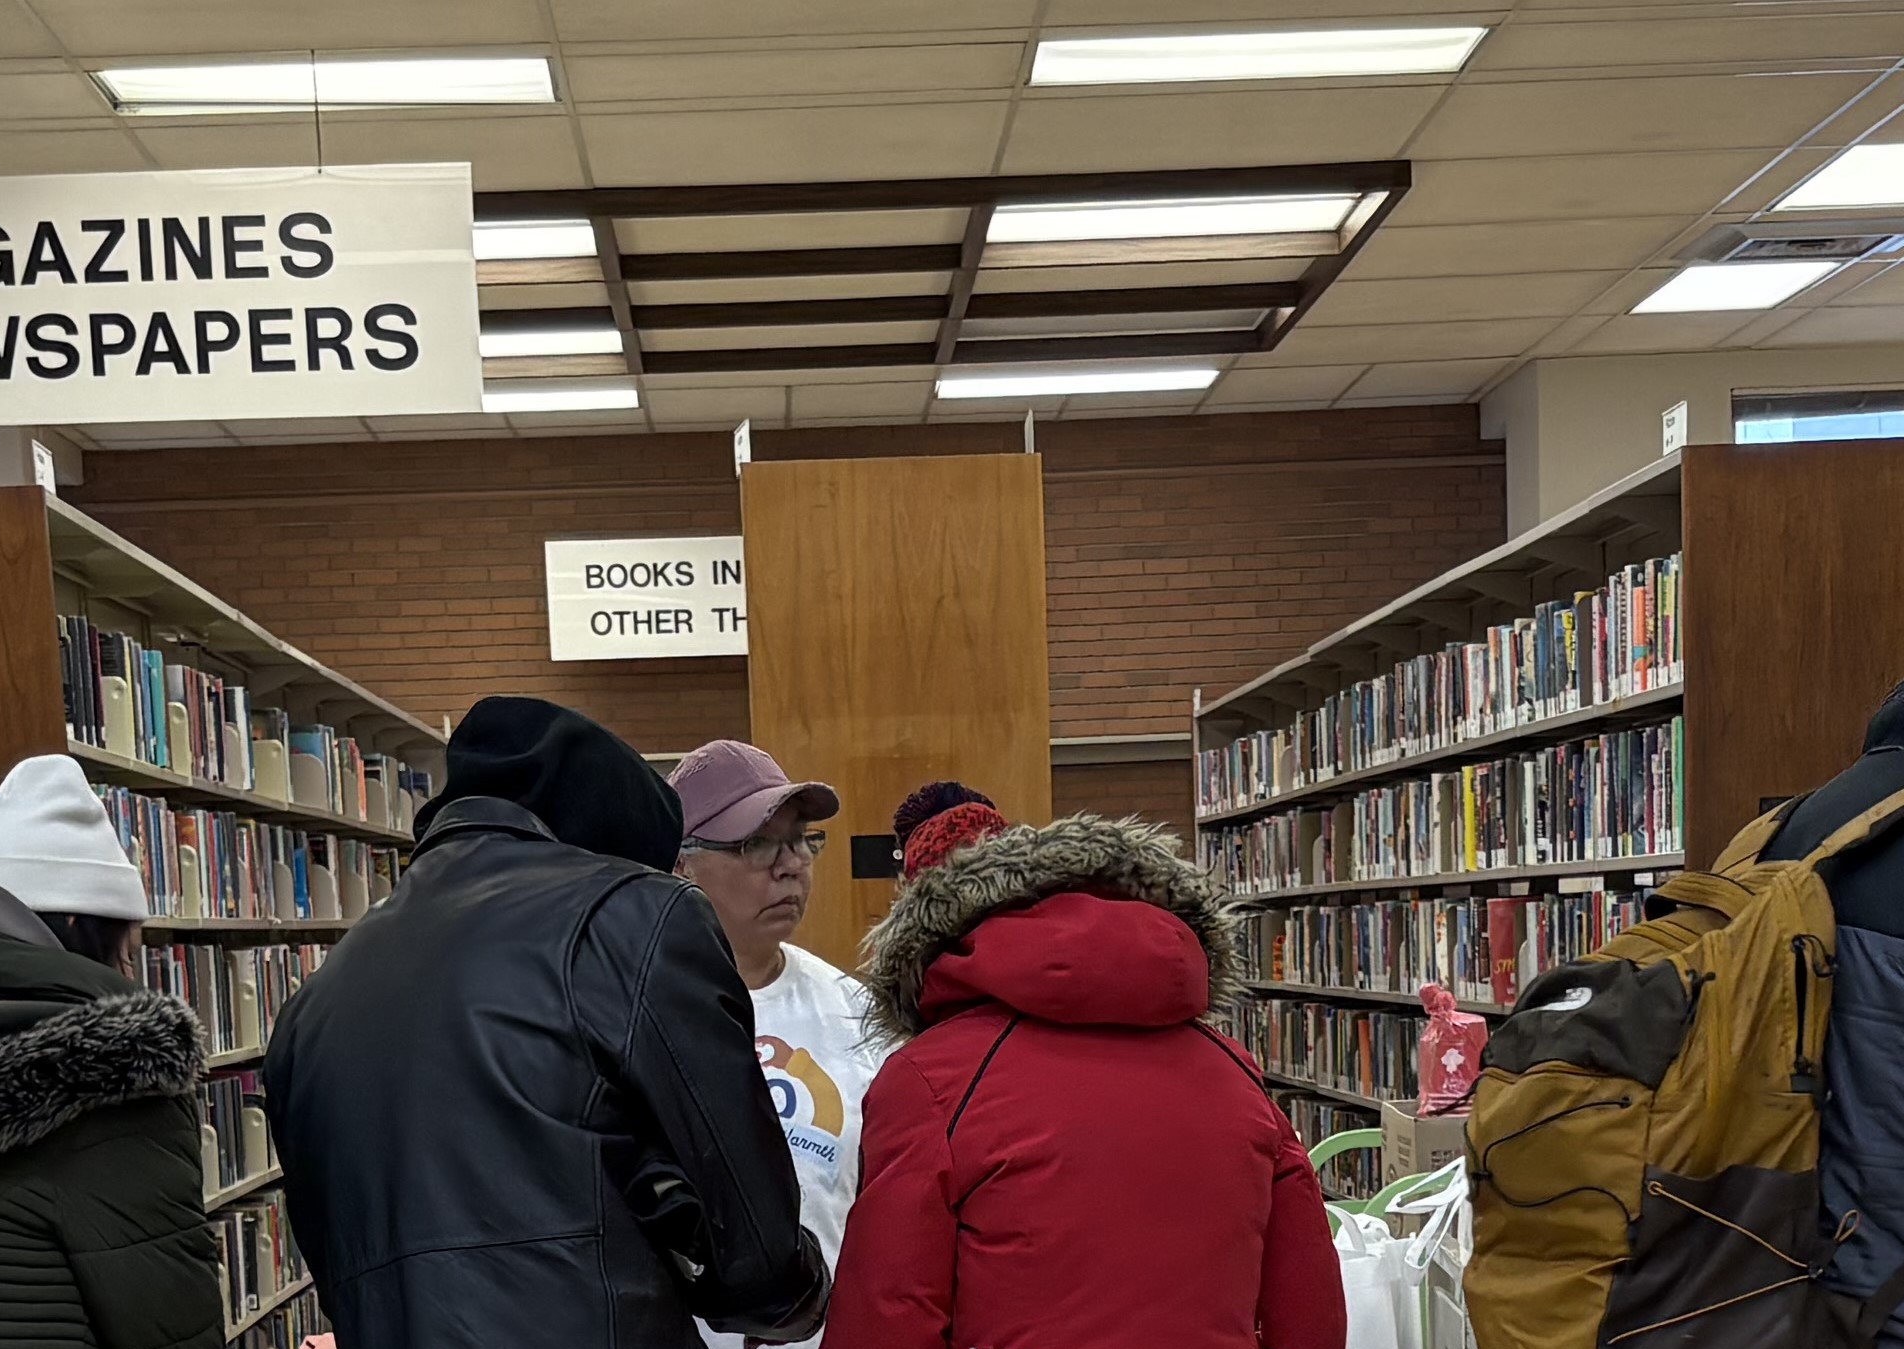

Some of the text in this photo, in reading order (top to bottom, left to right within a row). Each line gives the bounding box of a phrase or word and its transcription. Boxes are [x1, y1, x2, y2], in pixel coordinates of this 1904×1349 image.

[585, 560, 742, 589] BOOKS IN
[590, 608, 693, 636] OTHER
